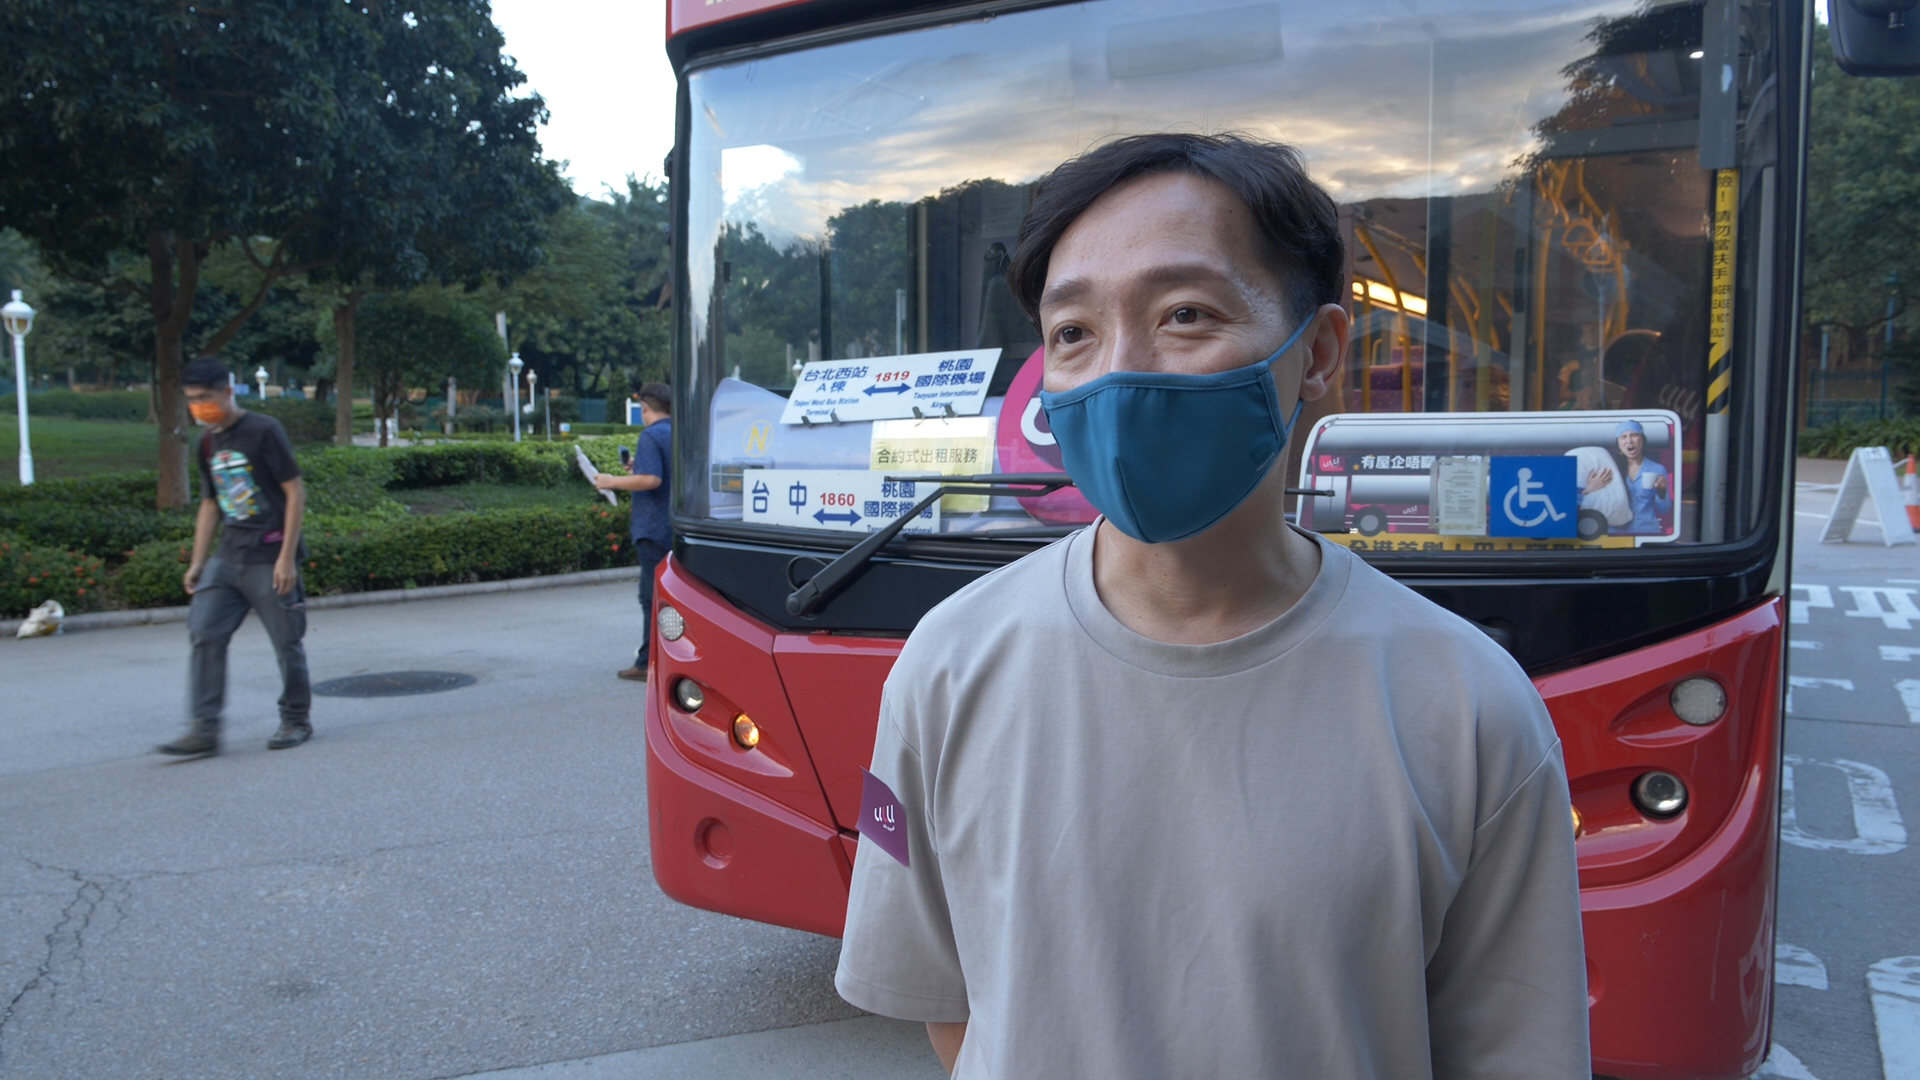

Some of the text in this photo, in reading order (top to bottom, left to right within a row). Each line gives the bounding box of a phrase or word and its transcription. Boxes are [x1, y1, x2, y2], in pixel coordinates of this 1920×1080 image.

[938, 358, 974, 372] 桃園
[804, 366, 869, 381] 台北西站
[875, 371, 910, 382] 1819
[915, 371, 986, 387] 國際機場
[913, 389, 979, 400] Taoyuan International
[805, 408, 831, 416] Terminal
[877, 448, 978, 464] 合約式出租服務
[881, 481, 916, 498] 桃園
[820, 492, 855, 507] 1860
